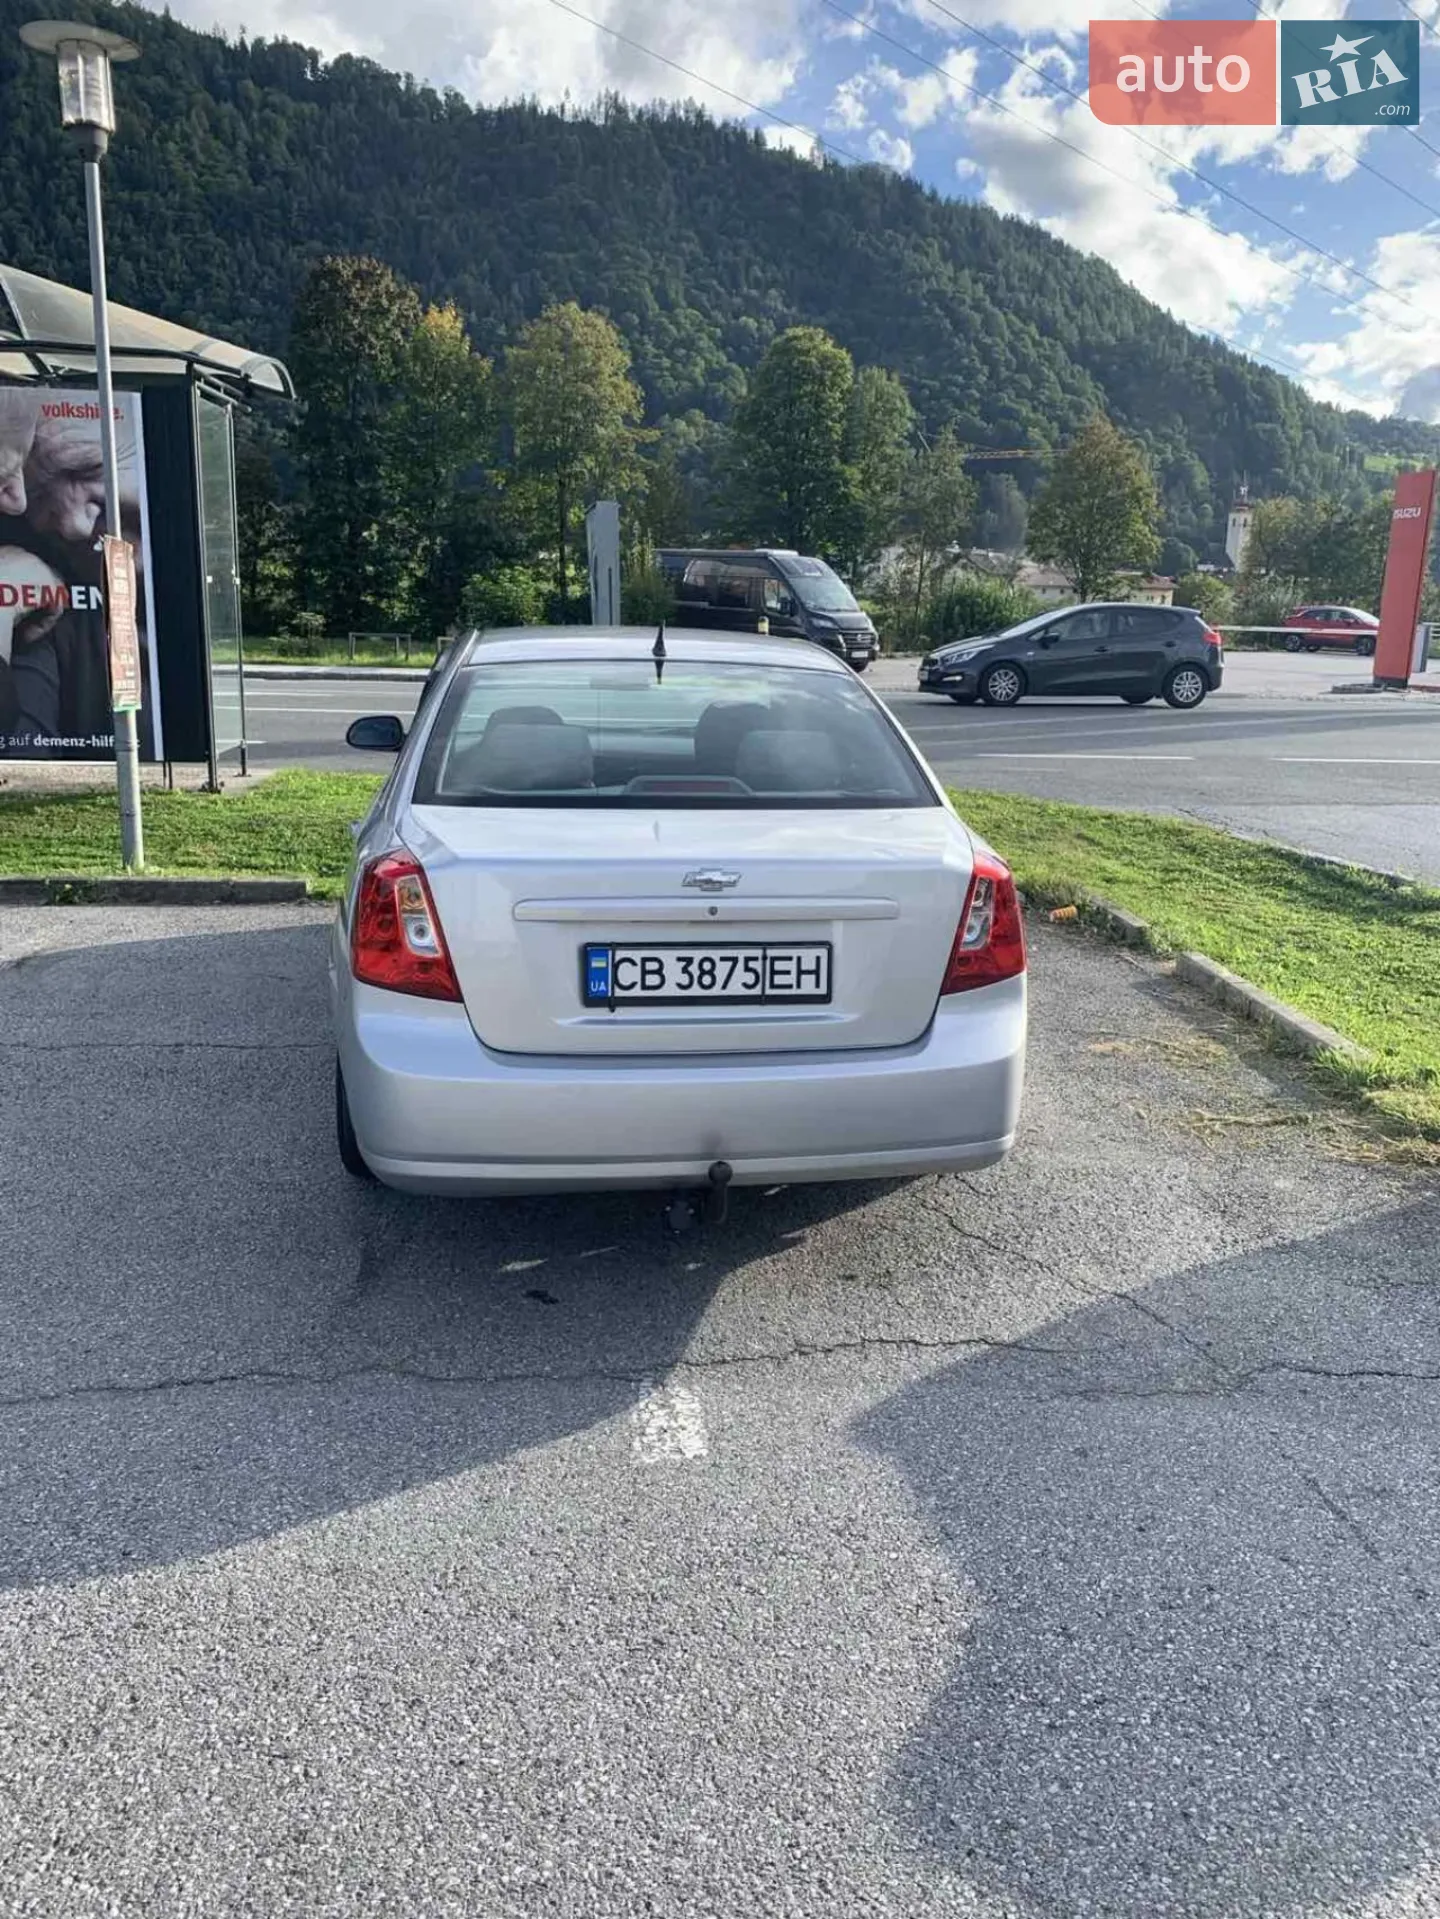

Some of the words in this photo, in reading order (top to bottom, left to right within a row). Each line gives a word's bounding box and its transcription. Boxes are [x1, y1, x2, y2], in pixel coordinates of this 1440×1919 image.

[41, 402, 125, 420] volkshie.
[0, 583, 104, 610] DEMEN
[8, 733, 31, 747] auf
[613, 956, 666, 991] CB
[675, 956, 760, 991] 3875
[768, 955, 821, 990] EH
[591, 980, 607, 992] UA
